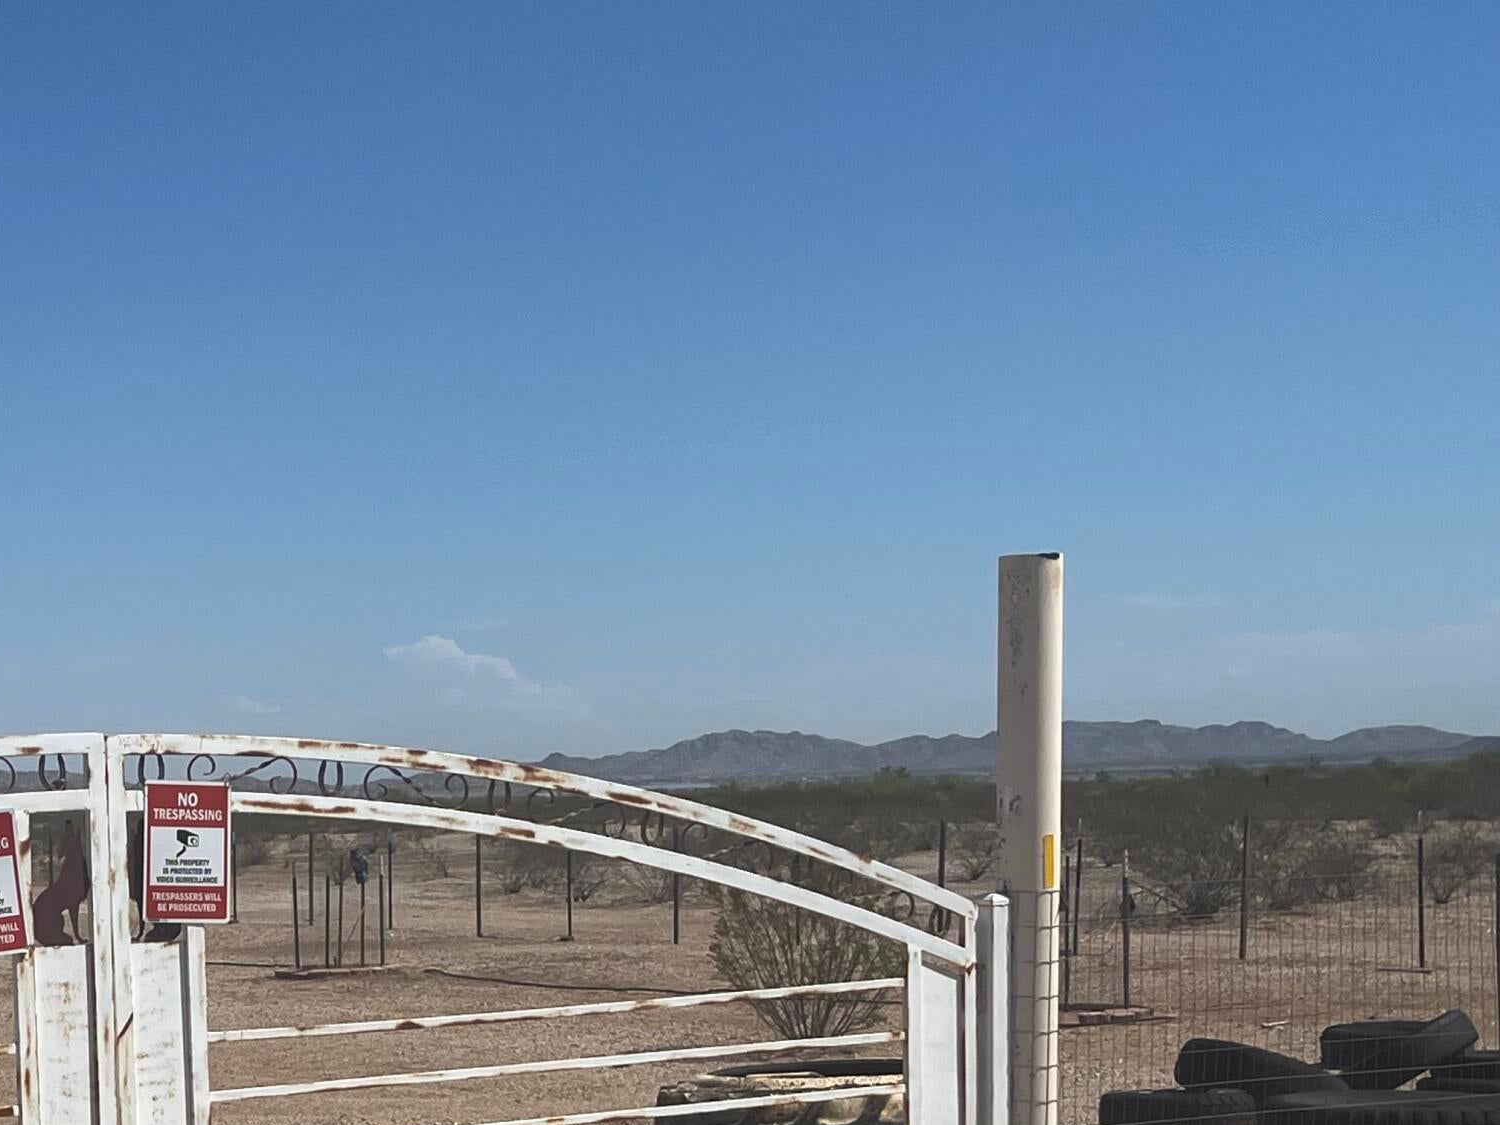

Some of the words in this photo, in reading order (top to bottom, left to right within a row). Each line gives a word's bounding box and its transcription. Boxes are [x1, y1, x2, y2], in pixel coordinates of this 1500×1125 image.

[178, 792, 198, 807] NO
[153, 808, 223, 821] TRESPASSING
[165, 858, 179, 866] THIS
[180, 859, 210, 867] PROPERTY
[175, 876, 218, 884] SURVEILLANCE
[152, 892, 203, 901] TRESPASSERS
[204, 892, 222, 902] WILL
[157, 903, 168, 912] BE
[168, 903, 217, 912] PROSECUTED
[0, 921, 20, 933] WILL
